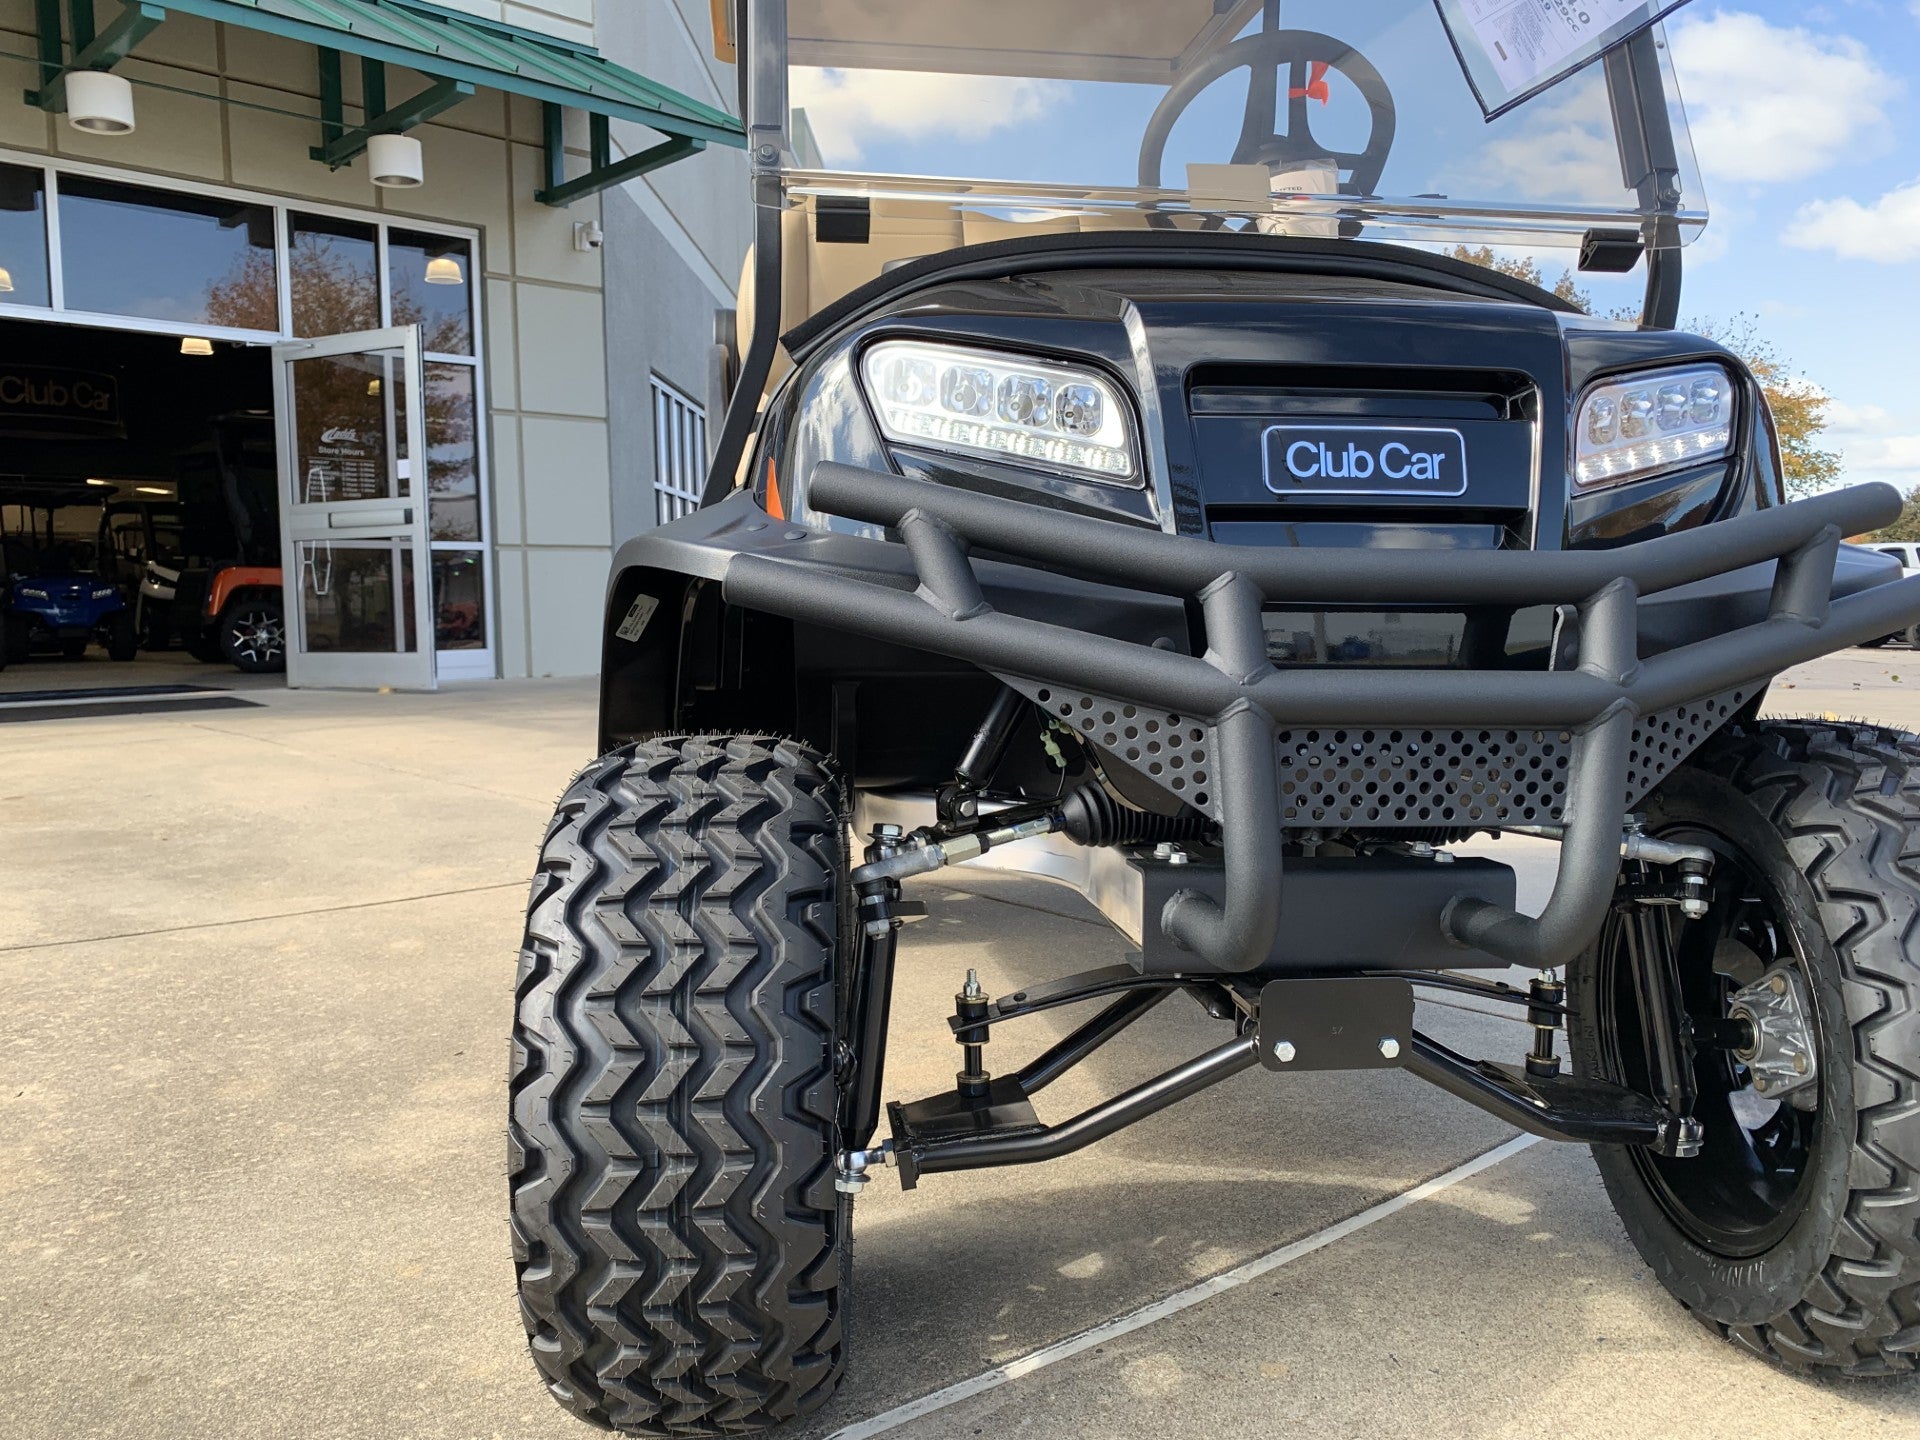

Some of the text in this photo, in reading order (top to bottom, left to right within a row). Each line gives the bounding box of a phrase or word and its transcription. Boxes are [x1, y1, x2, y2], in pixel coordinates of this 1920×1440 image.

[0, 375, 110, 411] Club Car
[318, 446, 366, 456] Store Hours
[1286, 440, 1446, 480] Club Car
